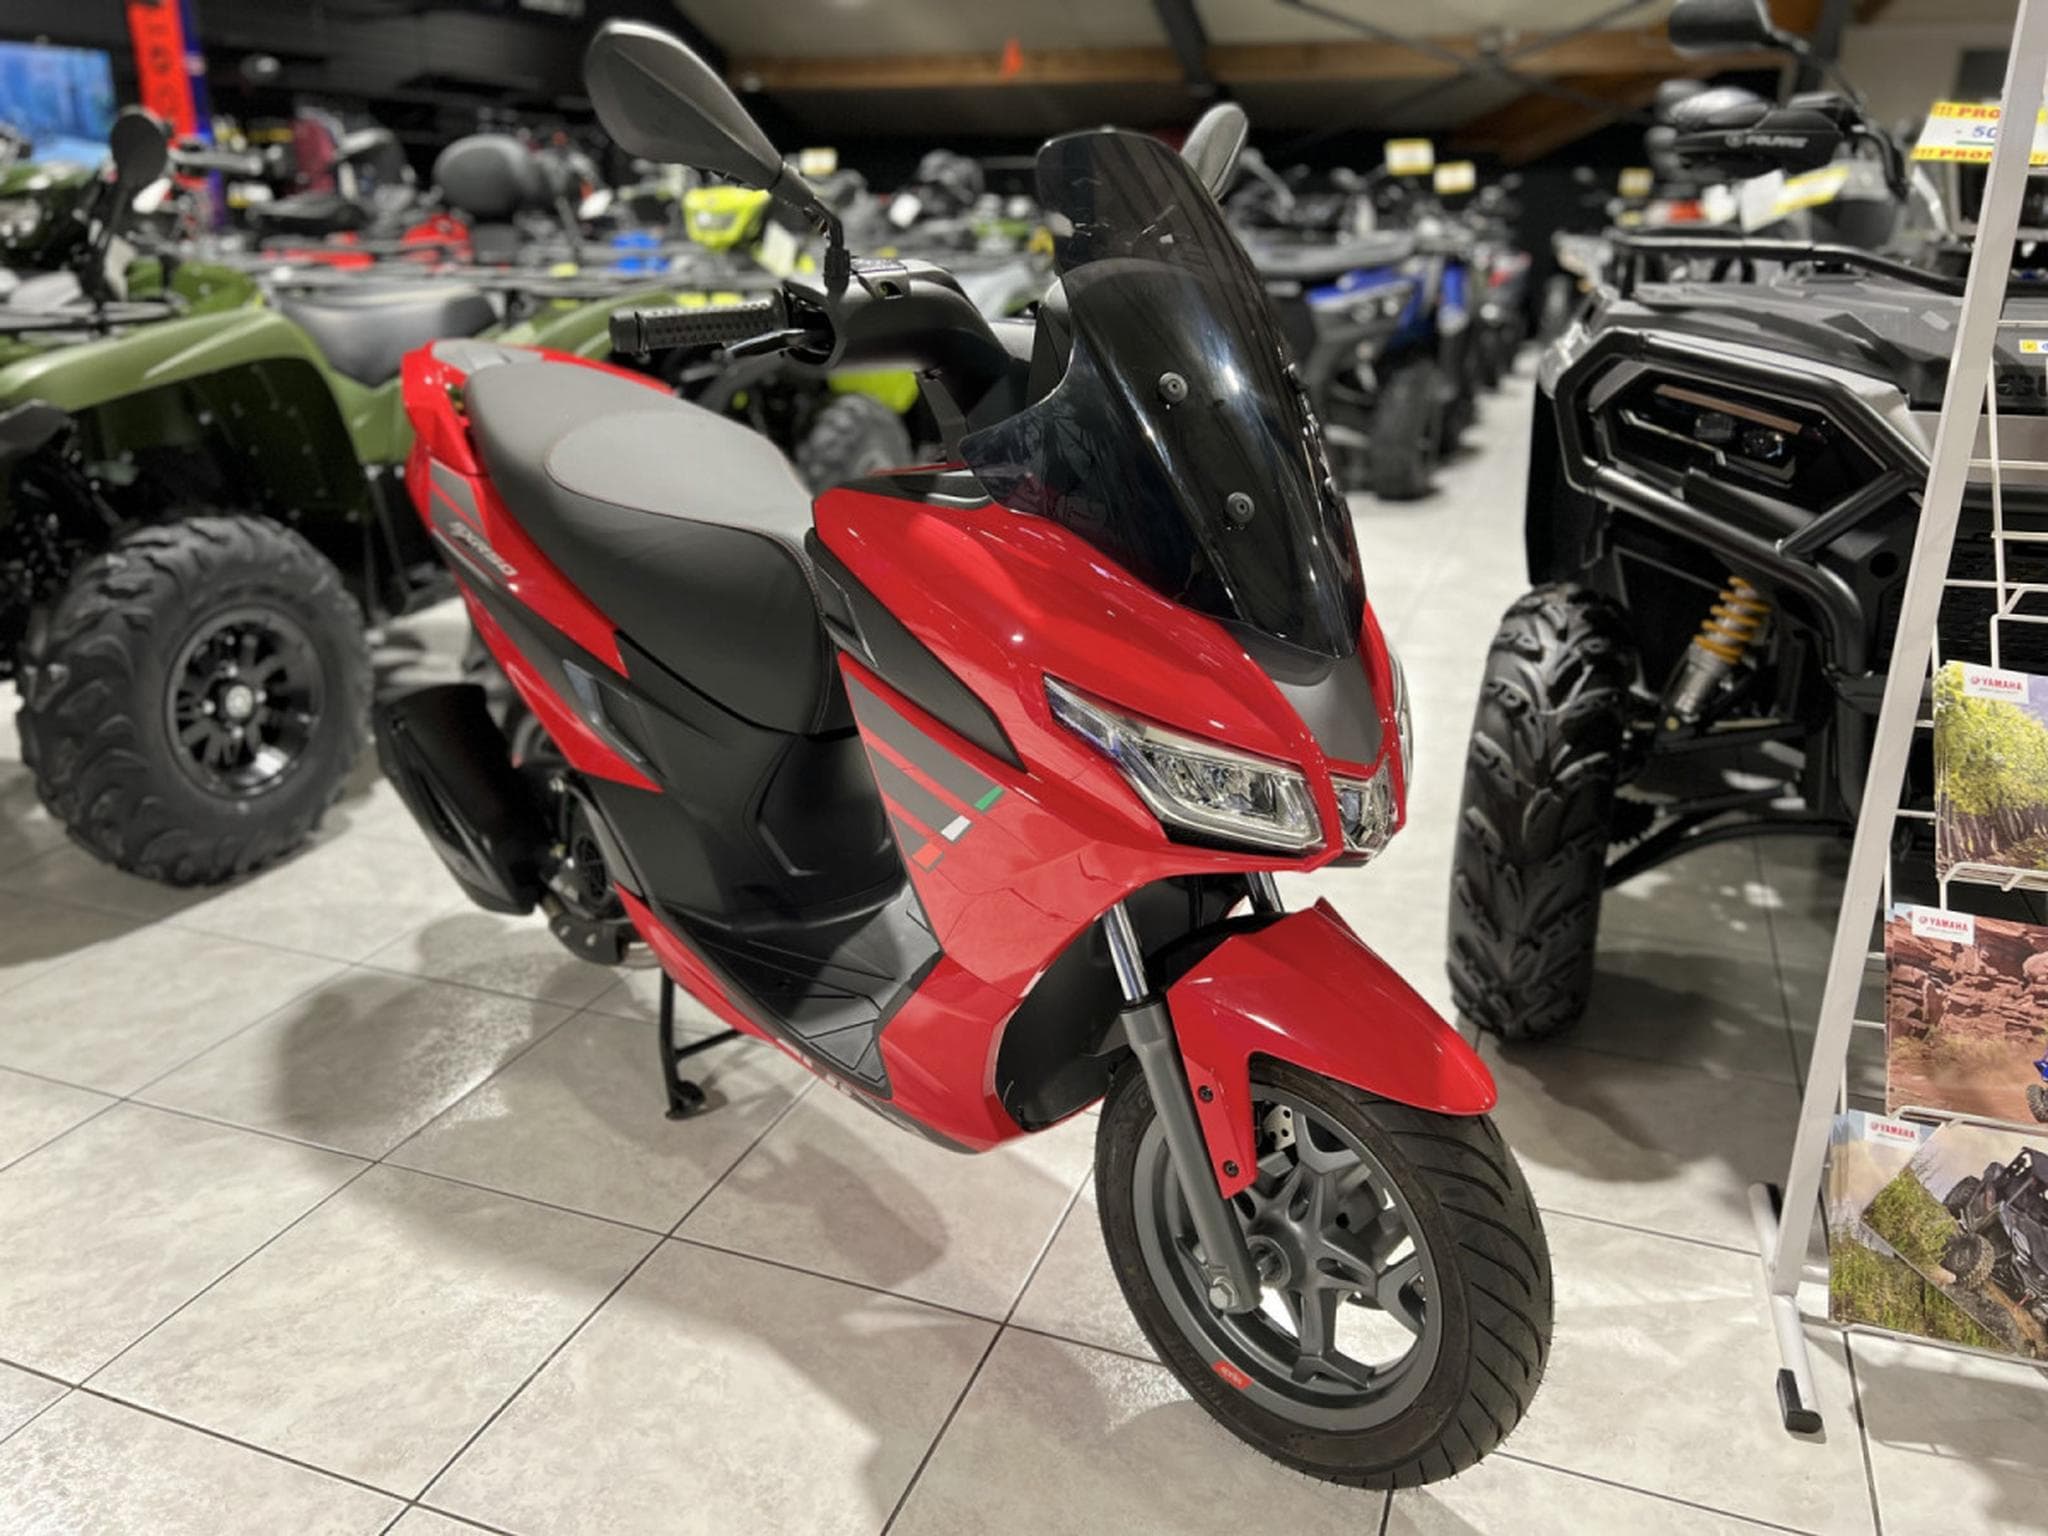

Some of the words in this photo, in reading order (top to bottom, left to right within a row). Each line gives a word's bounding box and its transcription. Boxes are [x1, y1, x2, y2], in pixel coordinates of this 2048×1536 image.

[1983, 677, 2022, 690] YAMAHA
[1930, 917, 1968, 931] YAMAHA
[1880, 1124, 1915, 1138] YAMAHA
